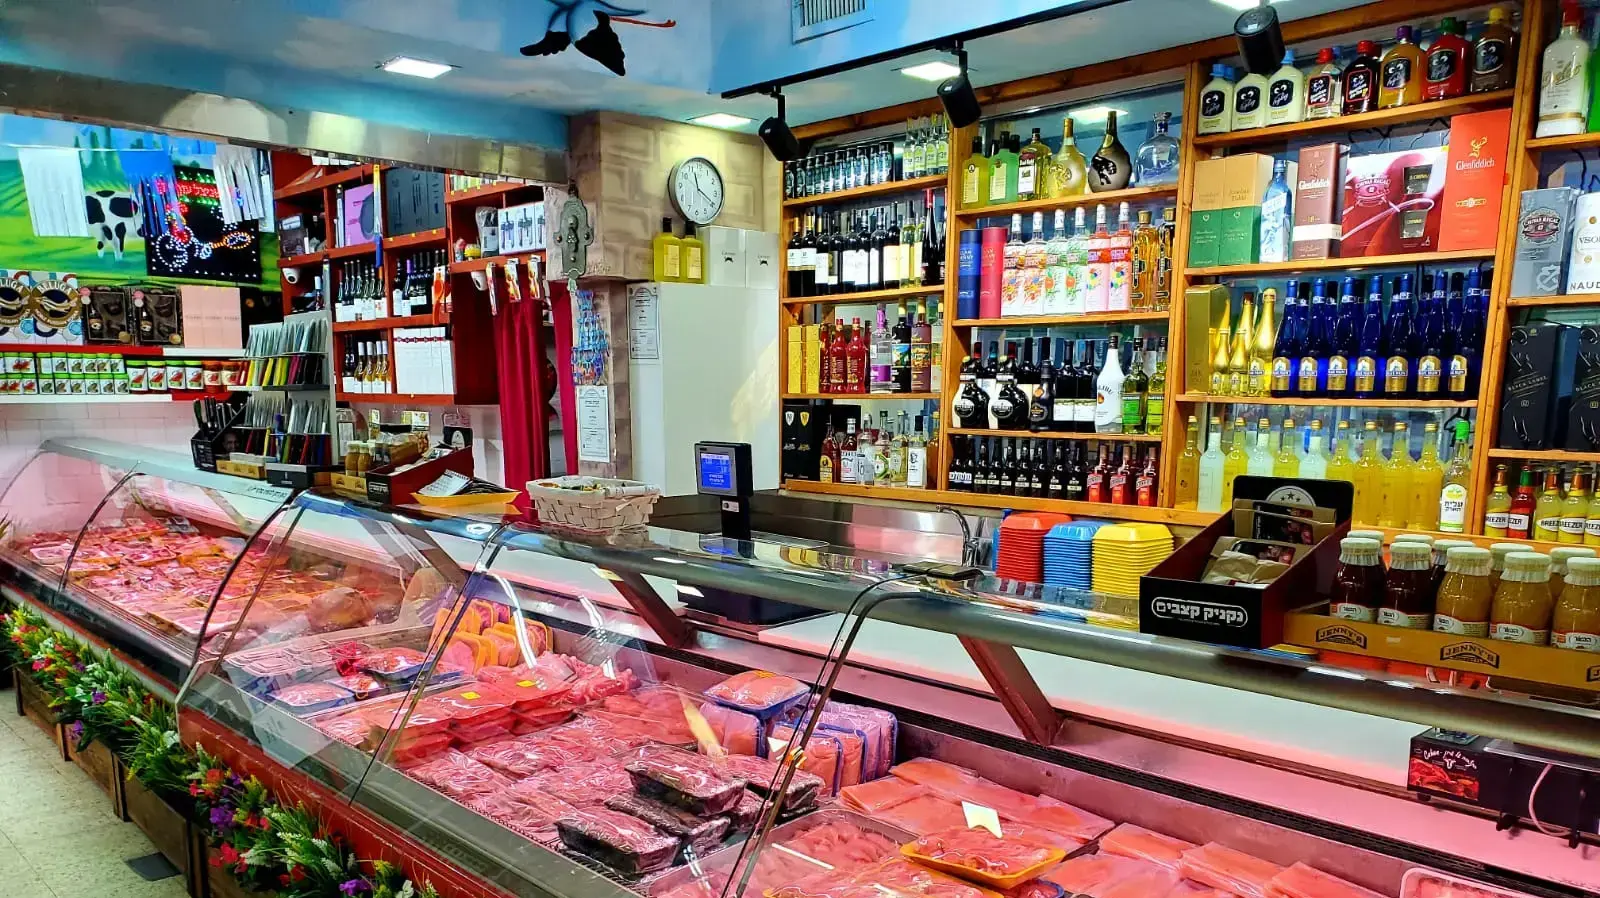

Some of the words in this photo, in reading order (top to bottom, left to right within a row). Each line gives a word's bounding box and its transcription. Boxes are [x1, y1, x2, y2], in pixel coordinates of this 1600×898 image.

[1456, 158, 1495, 170] Glenfiddich
[681, 172, 688, 180] 10
[38, 281, 72, 295] BELUGA
[1508, 382, 1527, 392] BLACK
[1575, 383, 1596, 392] BLACK
[1156, 601, 1201, 619] קצבים
[1203, 607, 1244, 624] נקניק
[1320, 627, 1362, 644] JENNY'S
[1445, 644, 1494, 662] JENNY'S
